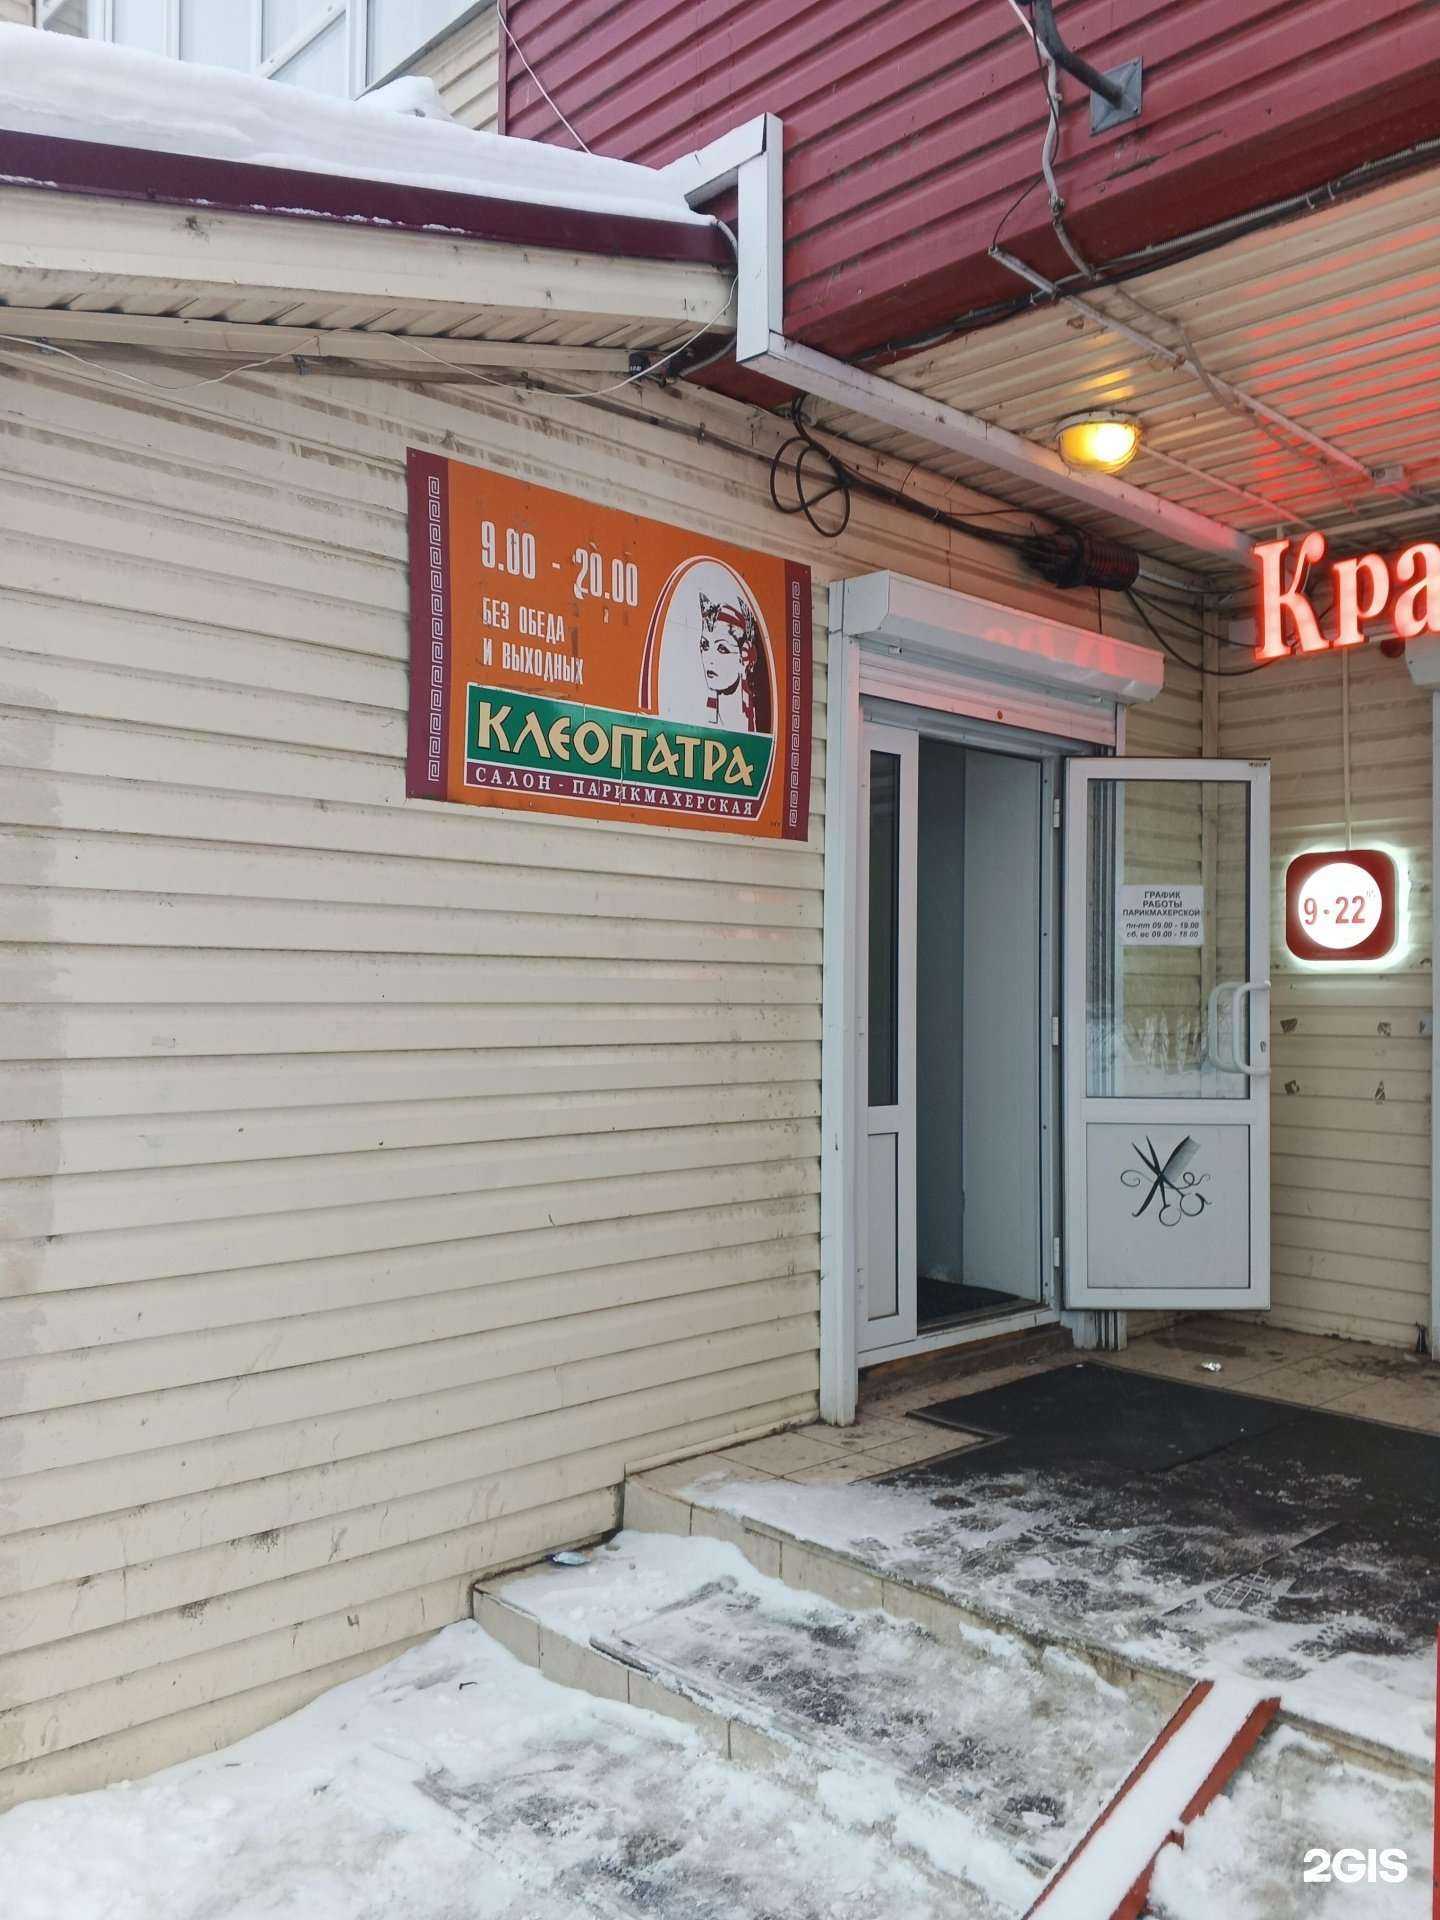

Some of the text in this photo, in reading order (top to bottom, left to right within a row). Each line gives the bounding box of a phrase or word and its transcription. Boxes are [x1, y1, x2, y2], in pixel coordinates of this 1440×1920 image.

[481, 520, 536, 580] 9.00
[572, 548, 638, 607] 20.00
[1254, 531, 1440, 660] Кра
[482, 597, 565, 644] БЕЗ ОБЕДА
[483, 638, 584, 685] И ВЫХОДНЫХ
[477, 701, 754, 786] КЛЕОПАТРА
[475, 767, 551, 791] САЛОН
[572, 779, 753, 816] ПАРИКМАХЕРСКАЯ
[1122, 909, 1200, 917] ПАРИКМАХЕРСКОЙ
[1143, 900, 1182, 908] РАБОТЫ
[1144, 890, 1181, 899] ГРАФИК
